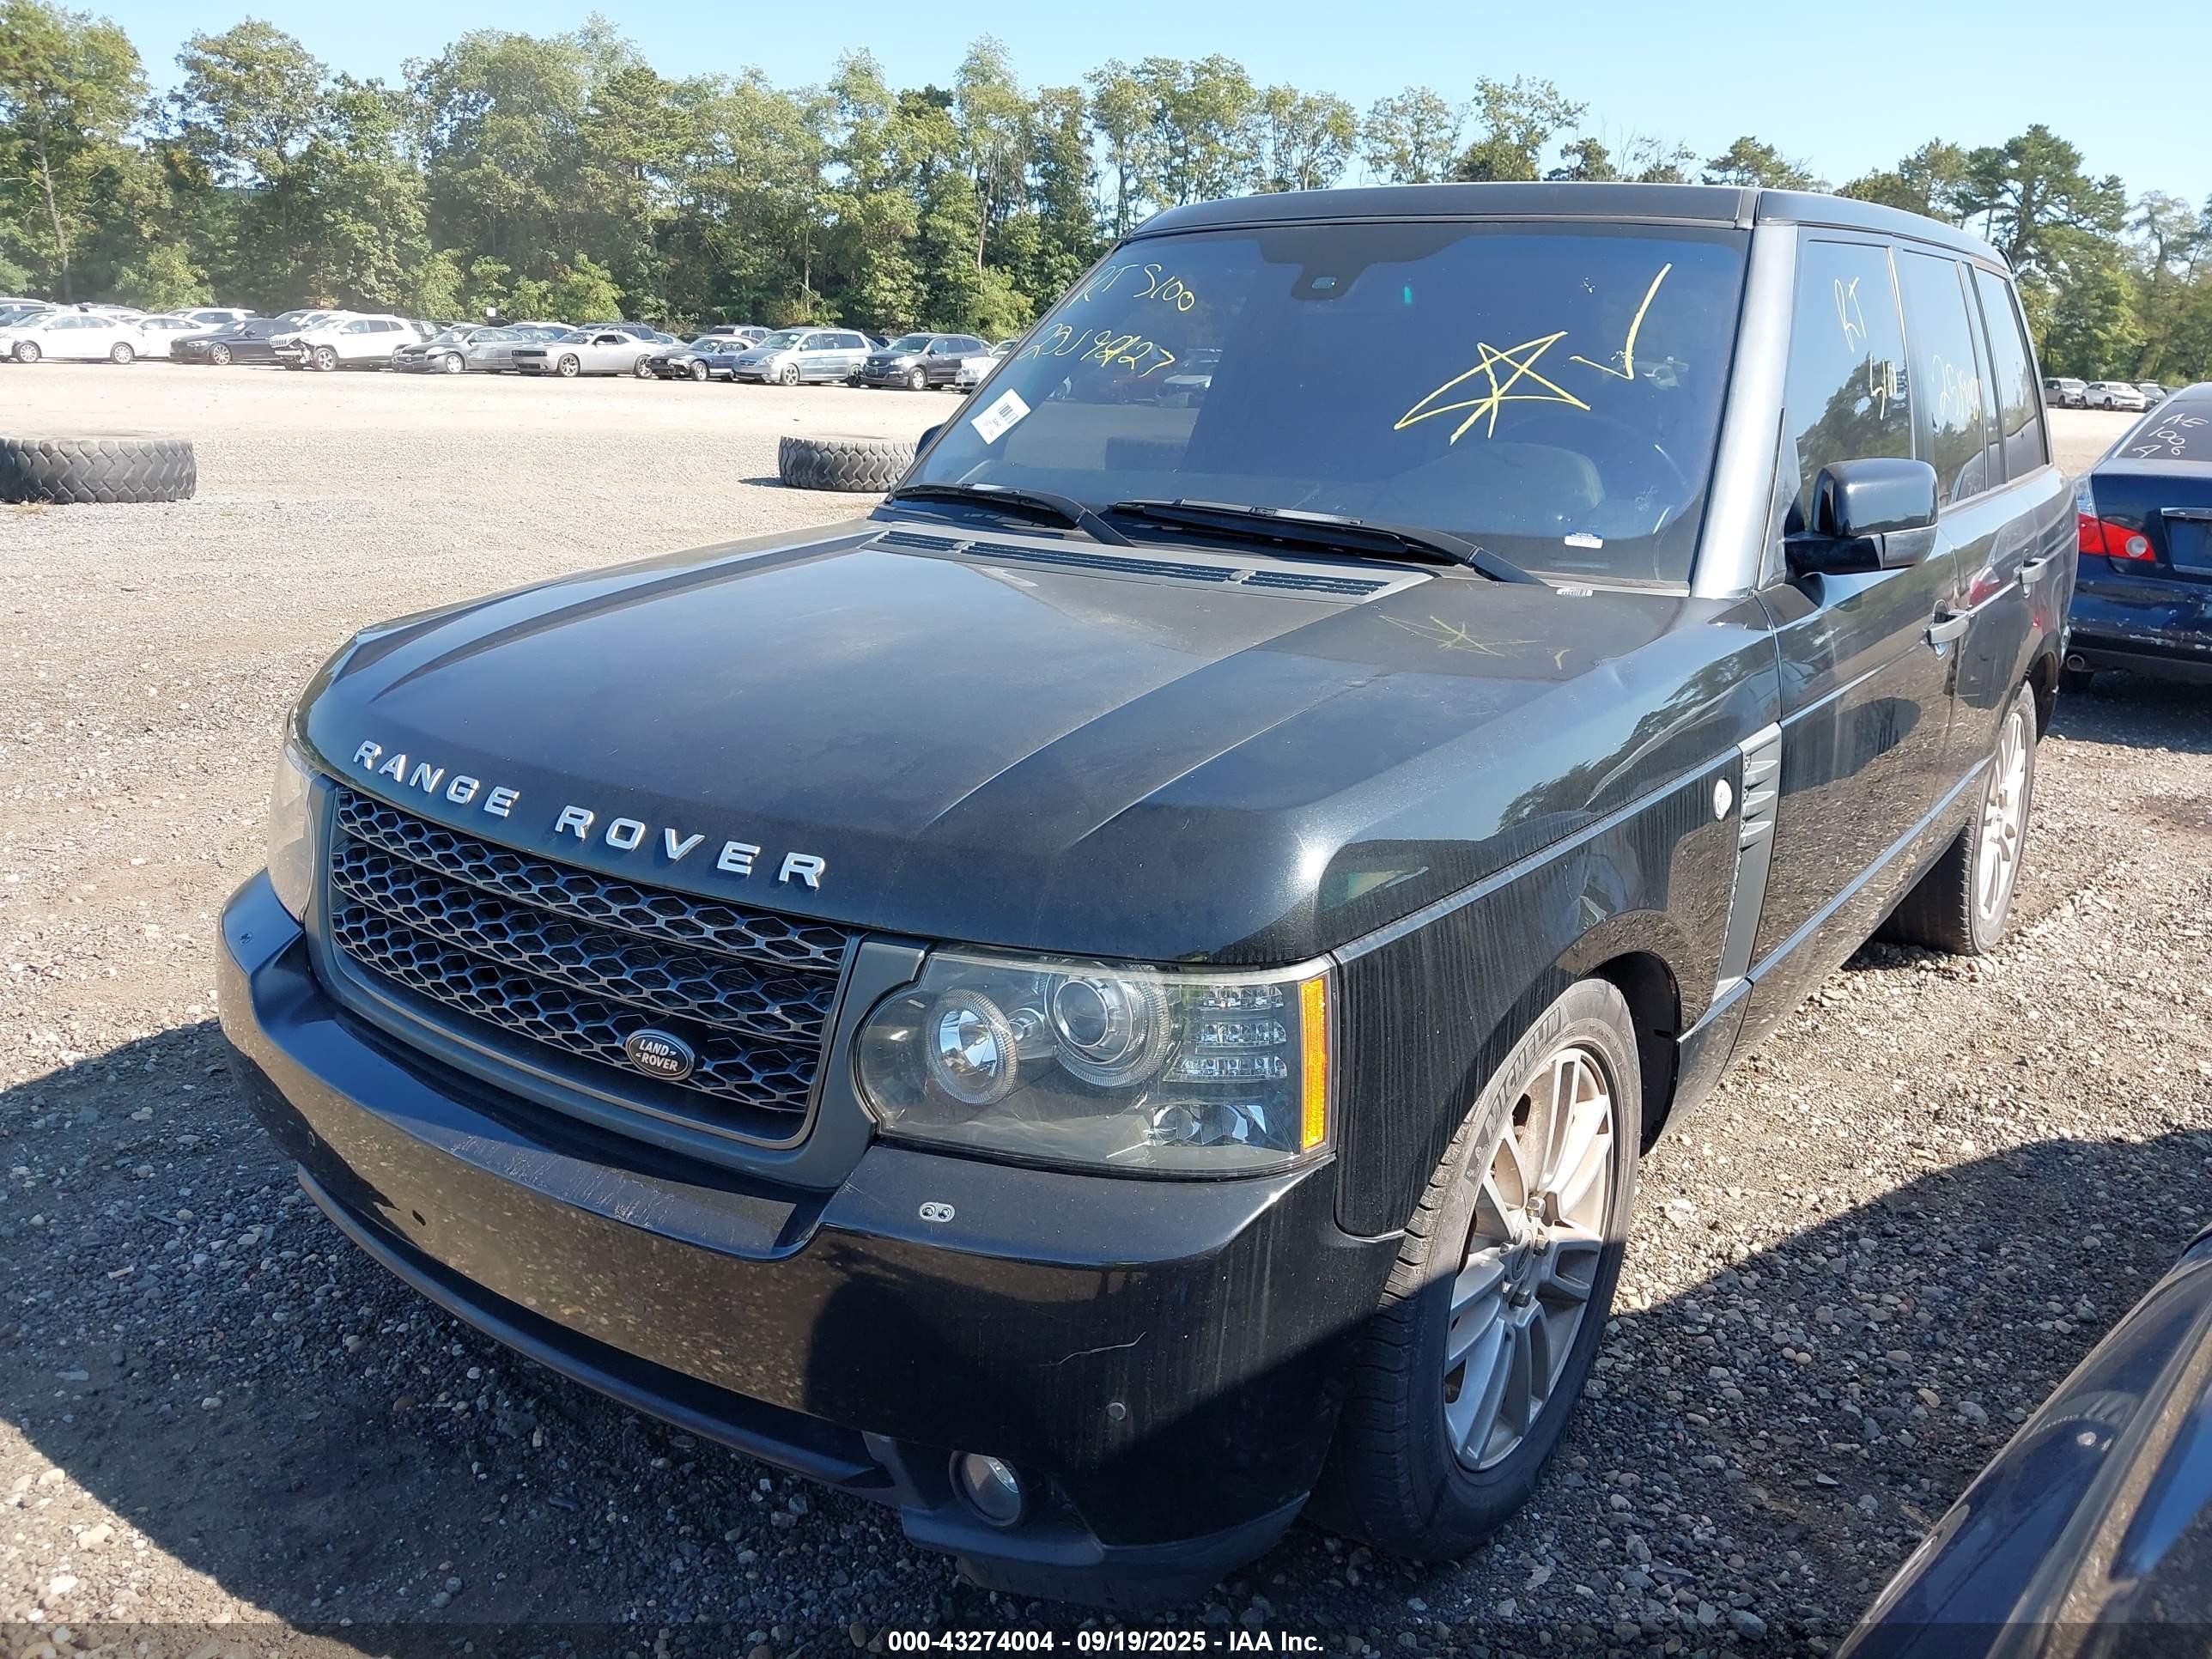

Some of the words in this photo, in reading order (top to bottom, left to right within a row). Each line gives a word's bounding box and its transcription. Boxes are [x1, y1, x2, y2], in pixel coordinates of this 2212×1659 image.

[352, 739, 520, 817] RANGE
[554, 804, 827, 890] ROVER
[638, 1038, 670, 1056] LAND
[641, 1052, 678, 1072] ROVER
[1485, 1007, 1561, 1140] MICHELIN
